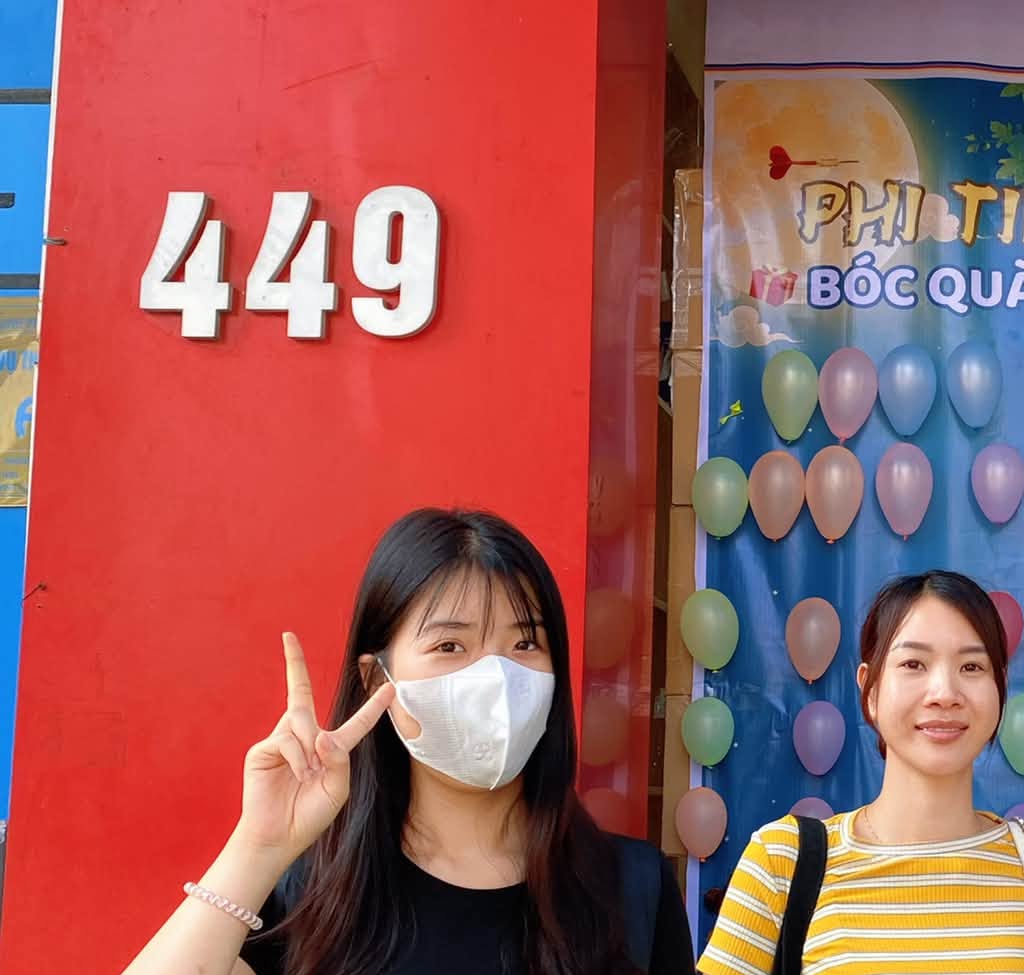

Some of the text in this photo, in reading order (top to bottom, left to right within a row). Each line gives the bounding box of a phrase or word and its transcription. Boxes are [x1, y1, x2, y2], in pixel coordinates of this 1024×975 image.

[799, 179, 926, 247] PHI
[139, 185, 441, 339] 449
[808, 252, 918, 308] BÓC
